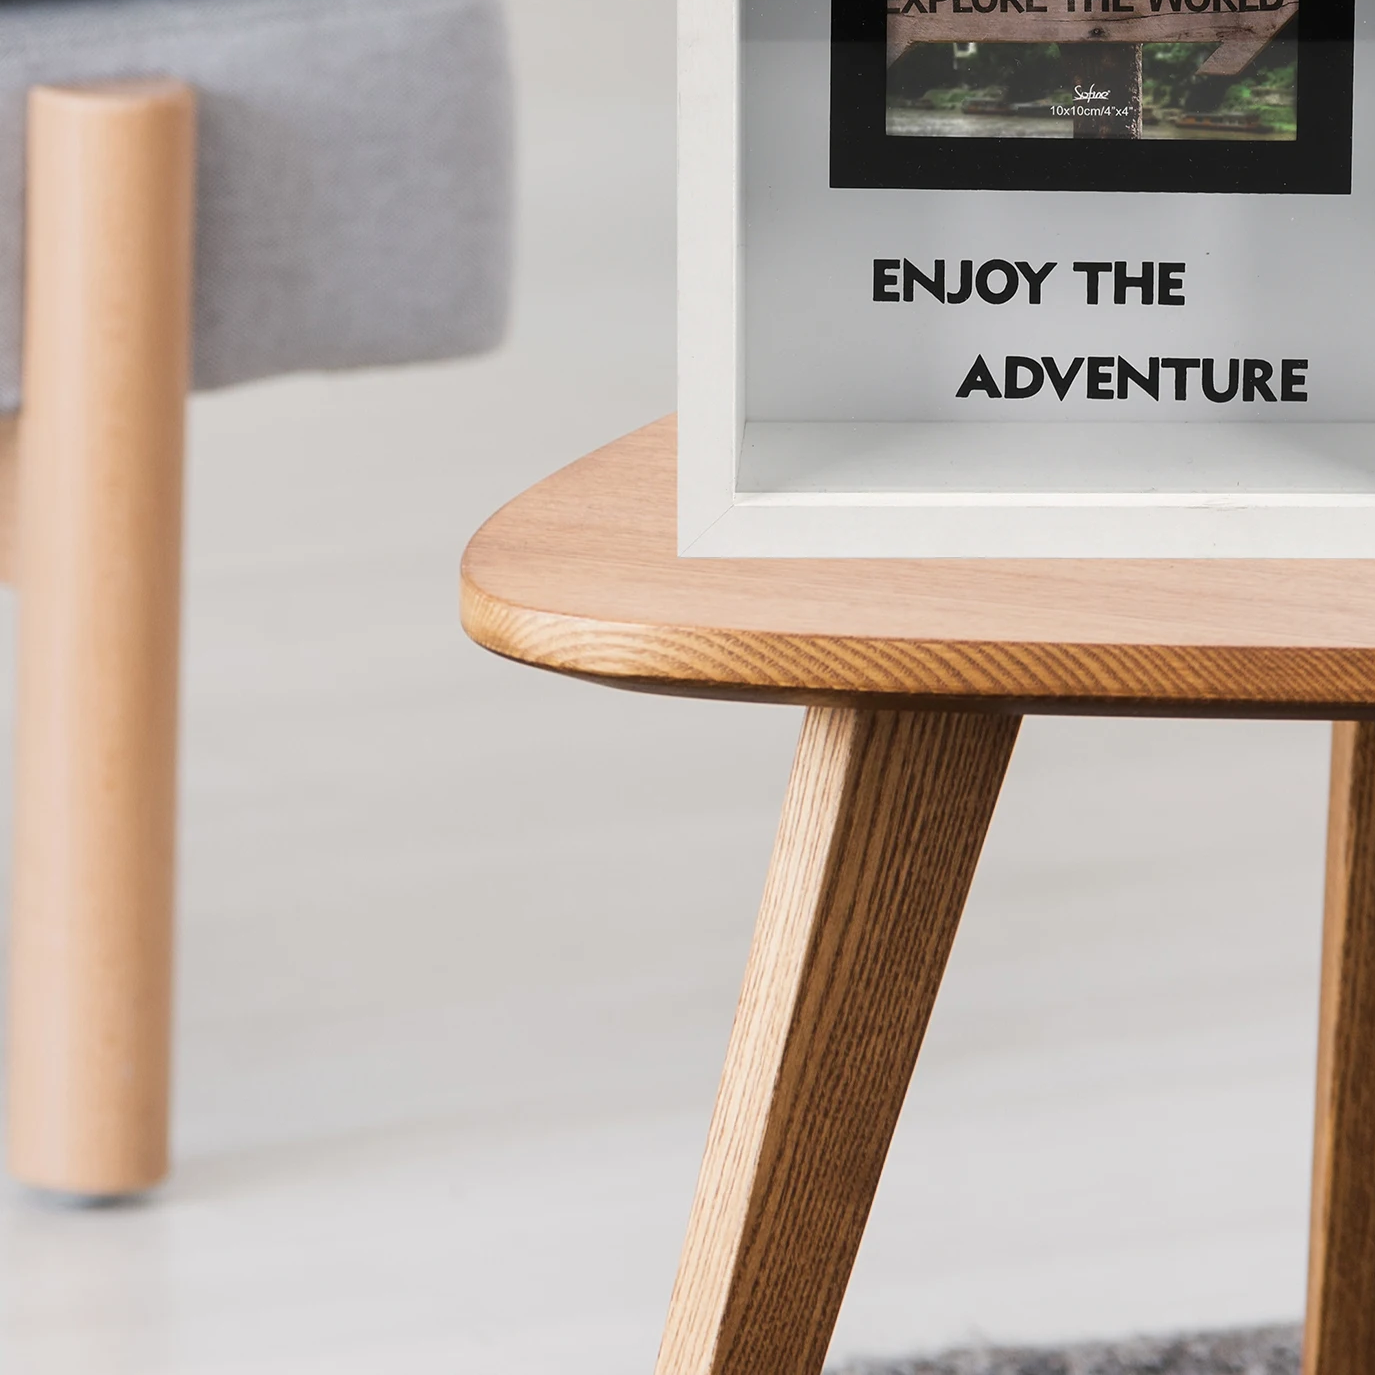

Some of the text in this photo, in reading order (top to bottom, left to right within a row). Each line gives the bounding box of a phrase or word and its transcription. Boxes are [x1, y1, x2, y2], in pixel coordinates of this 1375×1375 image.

[872, 258, 1186, 306] ENJOY THE
[955, 354, 1309, 403] ADVENTURE
